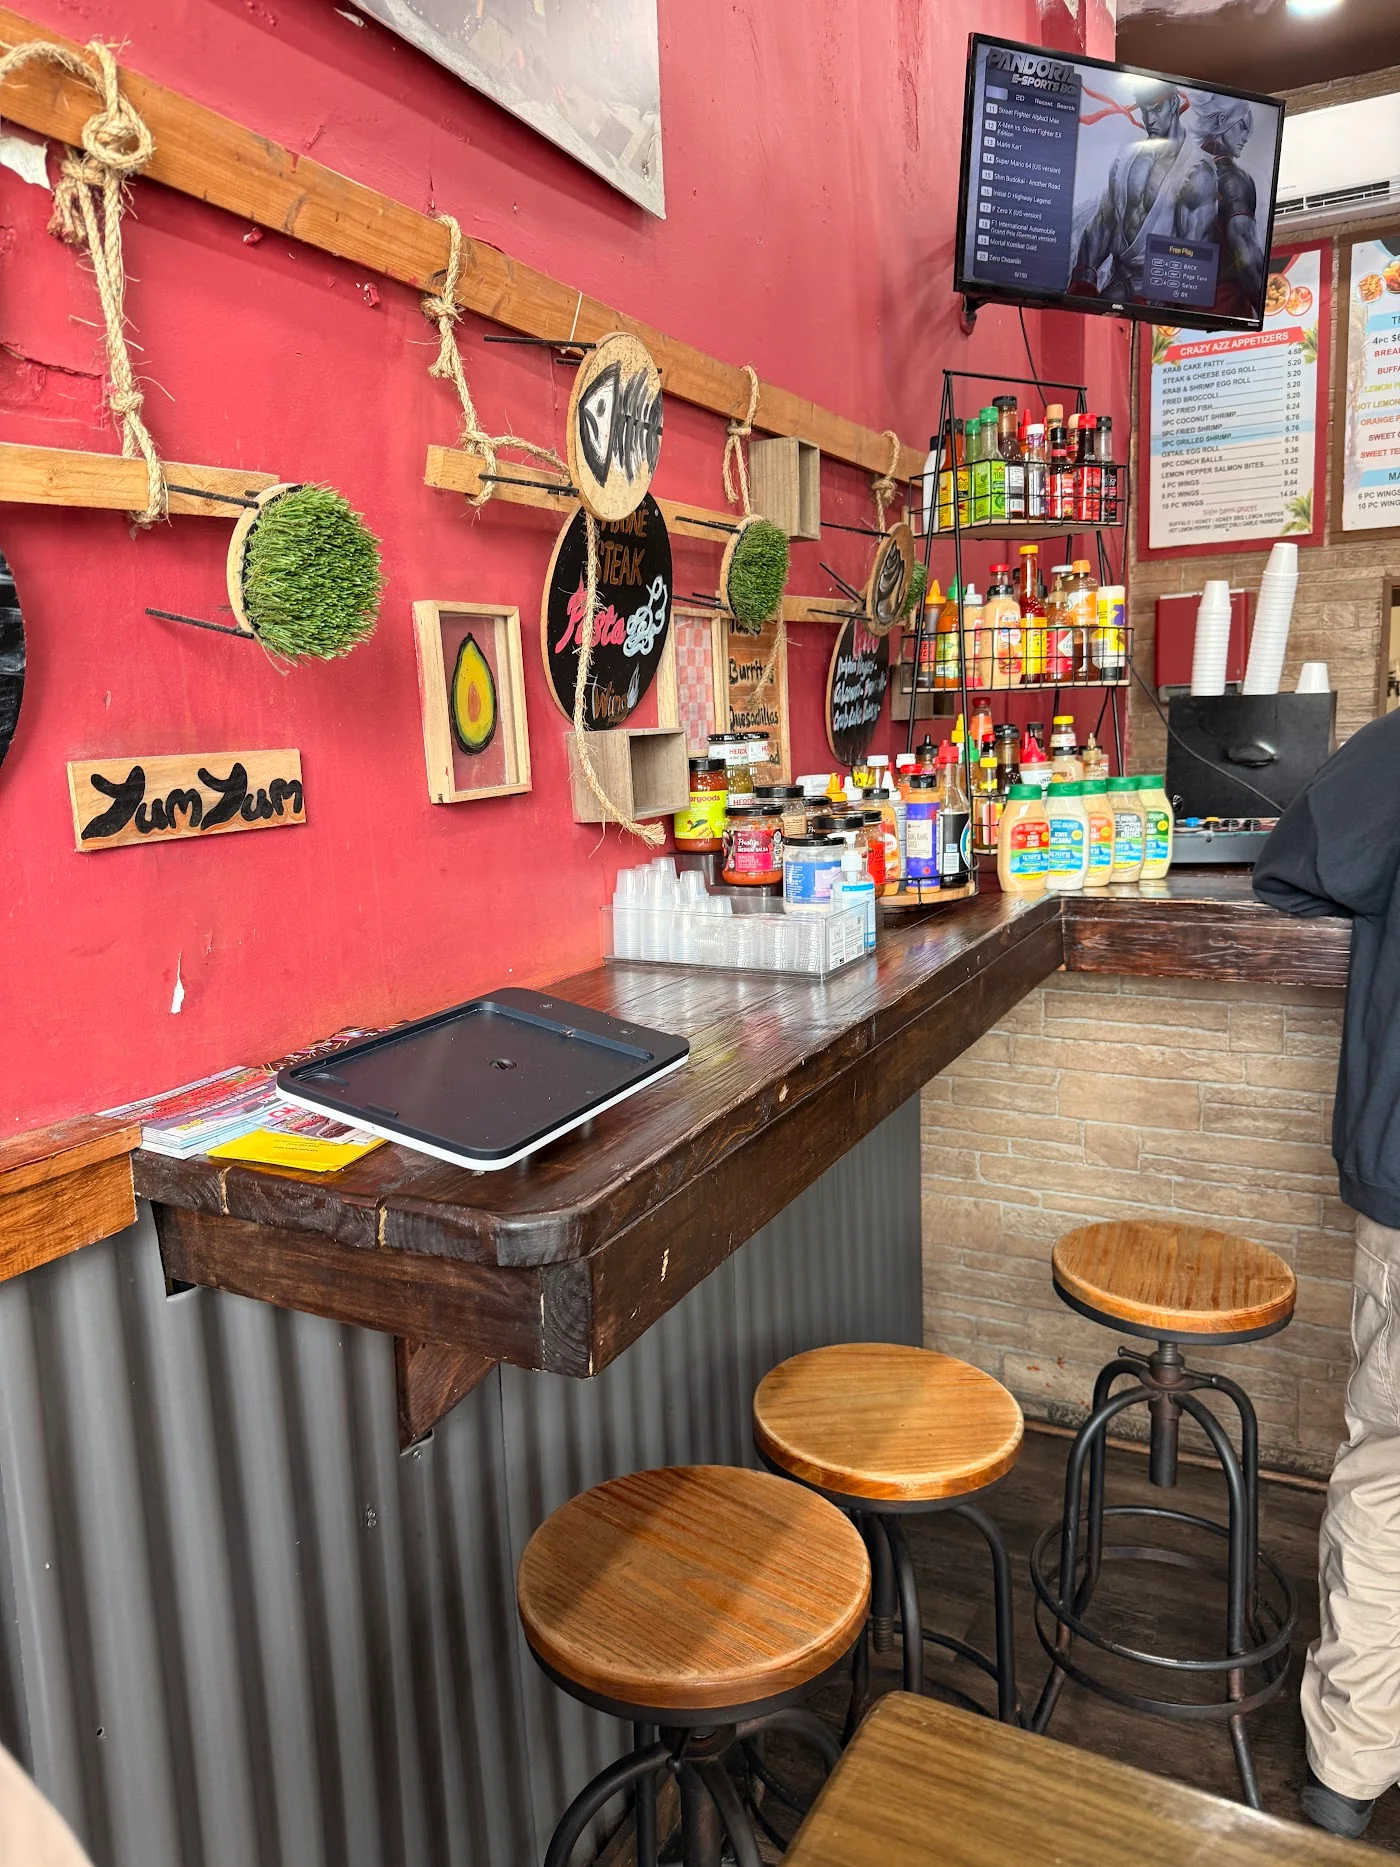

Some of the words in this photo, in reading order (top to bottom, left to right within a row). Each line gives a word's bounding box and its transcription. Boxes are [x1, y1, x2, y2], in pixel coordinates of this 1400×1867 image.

[988, 48, 1078, 83] PANDORA
[998, 107, 1013, 115] Street
[1014, 109, 1031, 120] Fighter
[997, 121, 1013, 130] X-Men
[1022, 125, 1037, 134] Street
[1037, 128, 1054, 138] Fighter
[1054, 131, 1063, 139] EX
[996, 140, 1011, 149] Mario
[1011, 143, 1022, 151] Kart
[995, 157, 1010, 165] Super
[1010, 159, 1025, 168] Mario
[1025, 161, 1032, 169] 64
[994, 173, 1005, 181] Shin
[1028, 179, 1047, 189] Another
[1047, 182, 1061, 190] Road
[993, 190, 1006, 198] Initial
[1012, 193, 1033, 203] Highway
[1033, 196, 1052, 205] Legend
[998, 220, 1029, 231] International
[1029, 225, 1056, 235] Automobile
[990, 238, 1006, 246] Mortal
[1006, 240, 1025, 249] Kombat
[1169, 245, 1181, 254] Free
[988, 254, 1001, 262] Zero
[1180, 343, 1212, 357] CRAZY
[1212, 340, 1231, 352] AZZ
[1231, 331, 1289, 349] APPETIZERS
[1372, 336, 1389, 345] 4PC
[1162, 365, 1182, 374] KRAB
[1183, 362, 1202, 371] CAKE
[1203, 359, 1225, 369] PATTY
[1287, 347, 1302, 356] 4.68
[1162, 375, 1185, 385] STEAK
[1192, 371, 1220, 380] CHEESE
[1221, 368, 1237, 377] EGG
[1238, 365, 1257, 374] ROLL
[1287, 358, 1302, 367] 5.20
[1162, 386, 1181, 395] KRAB
[1189, 382, 1215, 392] SHRIMP
[1216, 379, 1232, 388] EGG
[1232, 377, 1251, 386] ROLL
[1287, 369, 1301, 378] 5.20
[1364, 382, 1393, 393] LEMON
[1162, 397, 1182, 406] FRIED
[1183, 392, 1219, 402] BROCCOLI
[1286, 380, 1301, 389] 5.20
[1176, 406, 1196, 414] FRIED
[1197, 403, 1213, 412] FISH
[1286, 391, 1301, 400] 5.20
[1175, 414, 1210, 425] COCONUT
[1210, 411, 1237, 420] SHRIMP
[1360, 415, 1395, 426] ORANGE
[1175, 427, 1196, 436] FRIED
[1197, 423, 1223, 433] SHRIMP
[1175, 436, 1205, 446] GRILLED
[1206, 433, 1232, 443] SHRIMP
[1368, 431, 1396, 442] SWEET
[1161, 450, 1185, 458] OXTAIL
[1186, 447, 1201, 455] EGG
[1201, 445, 1220, 453] ROLL
[1360, 448, 1388, 459] SWEET
[1175, 457, 1200, 467] CONCH
[1200, 455, 1223, 464] BALLS
[1161, 470, 1185, 479] LEMON
[1185, 467, 1213, 477] PEPPER
[1213, 463, 1243, 473] SALMON
[1243, 461, 1264, 470] BITES
[1166, 481, 1176, 489] PC
[1178, 479, 1200, 488] WINGS
[1166, 491, 1176, 499] PC
[1177, 489, 1200, 498] WINGS
[1364, 491, 1375, 499] PC
[1170, 501, 1180, 509] PC
[1181, 499, 1204, 508] WINGS
[1367, 501, 1379, 509] PC
